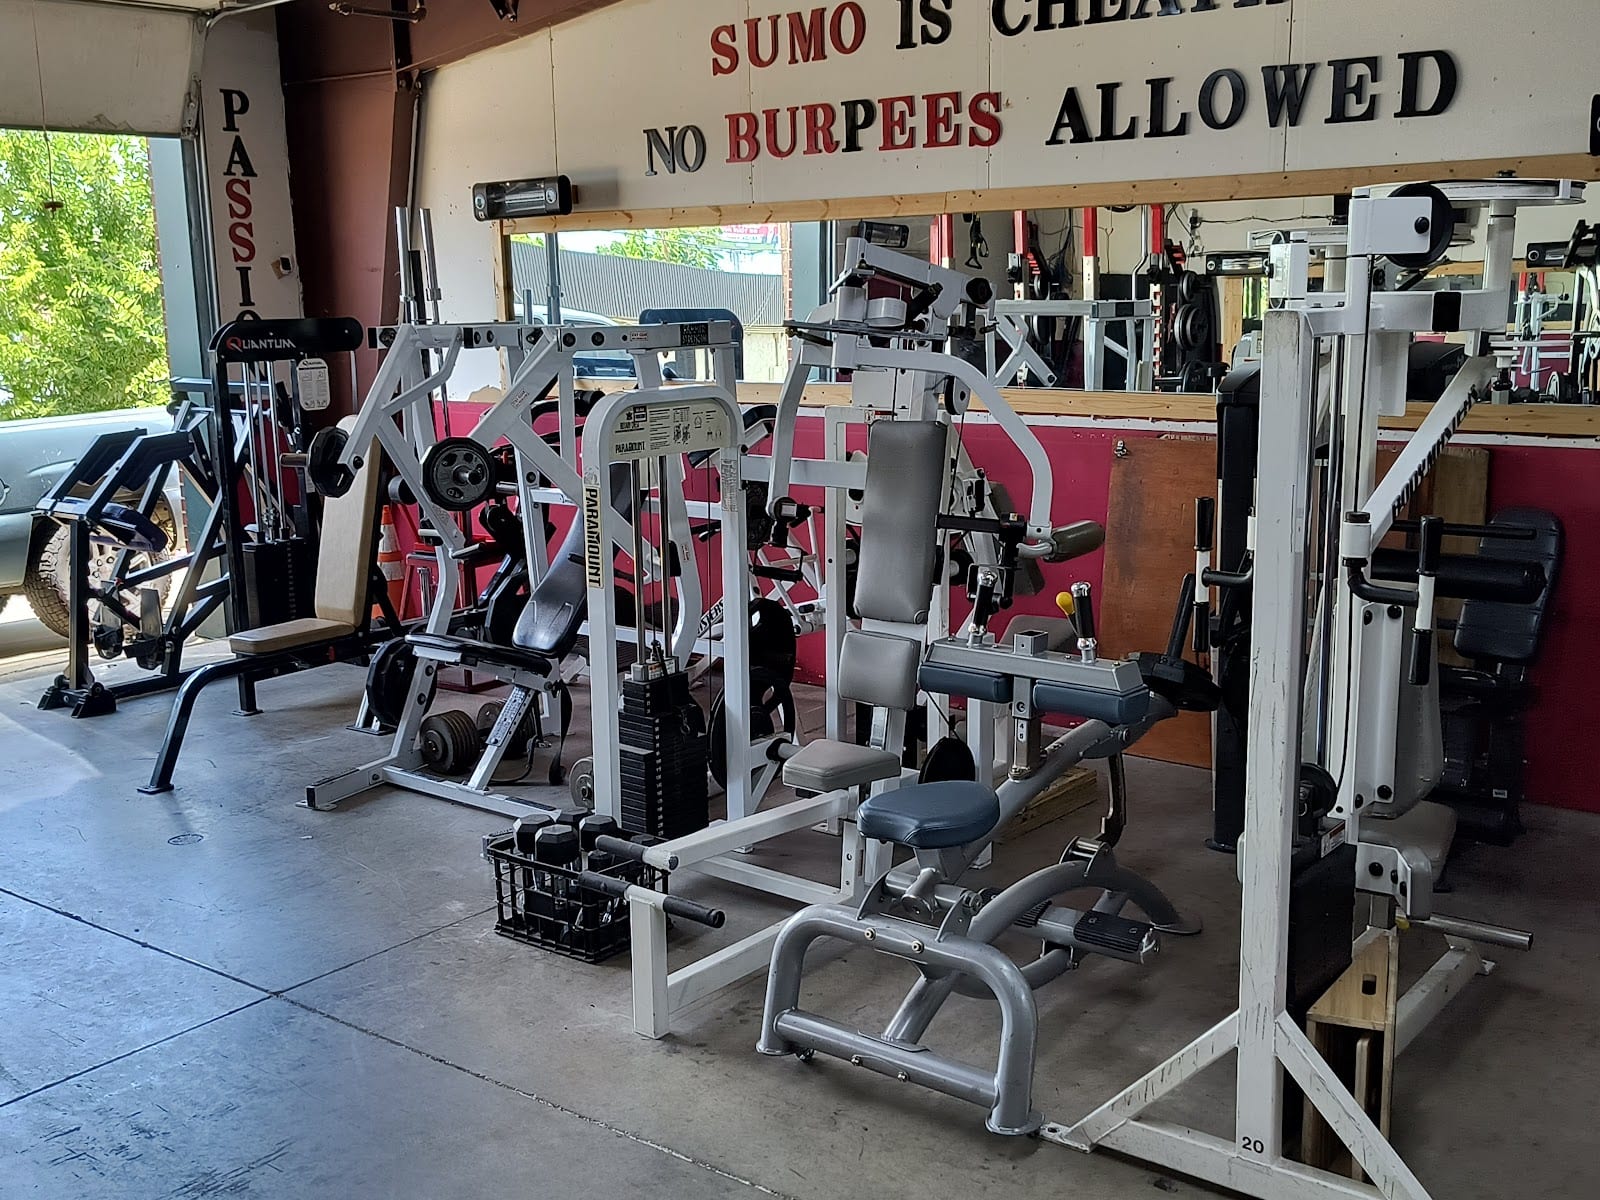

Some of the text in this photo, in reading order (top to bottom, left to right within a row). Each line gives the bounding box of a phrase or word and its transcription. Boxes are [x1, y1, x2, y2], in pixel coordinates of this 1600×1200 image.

[711, 1, 866, 76] SUMO
[896, 0, 952, 49] IS
[642, 49, 1458, 177] NO BURPEES ALLOWED
[219, 88, 268, 381] PASSI
[226, 336, 297, 353] QUANTUM
[586, 487, 602, 588] PARAMOUNT
[1242, 1136, 1264, 1154] 20
